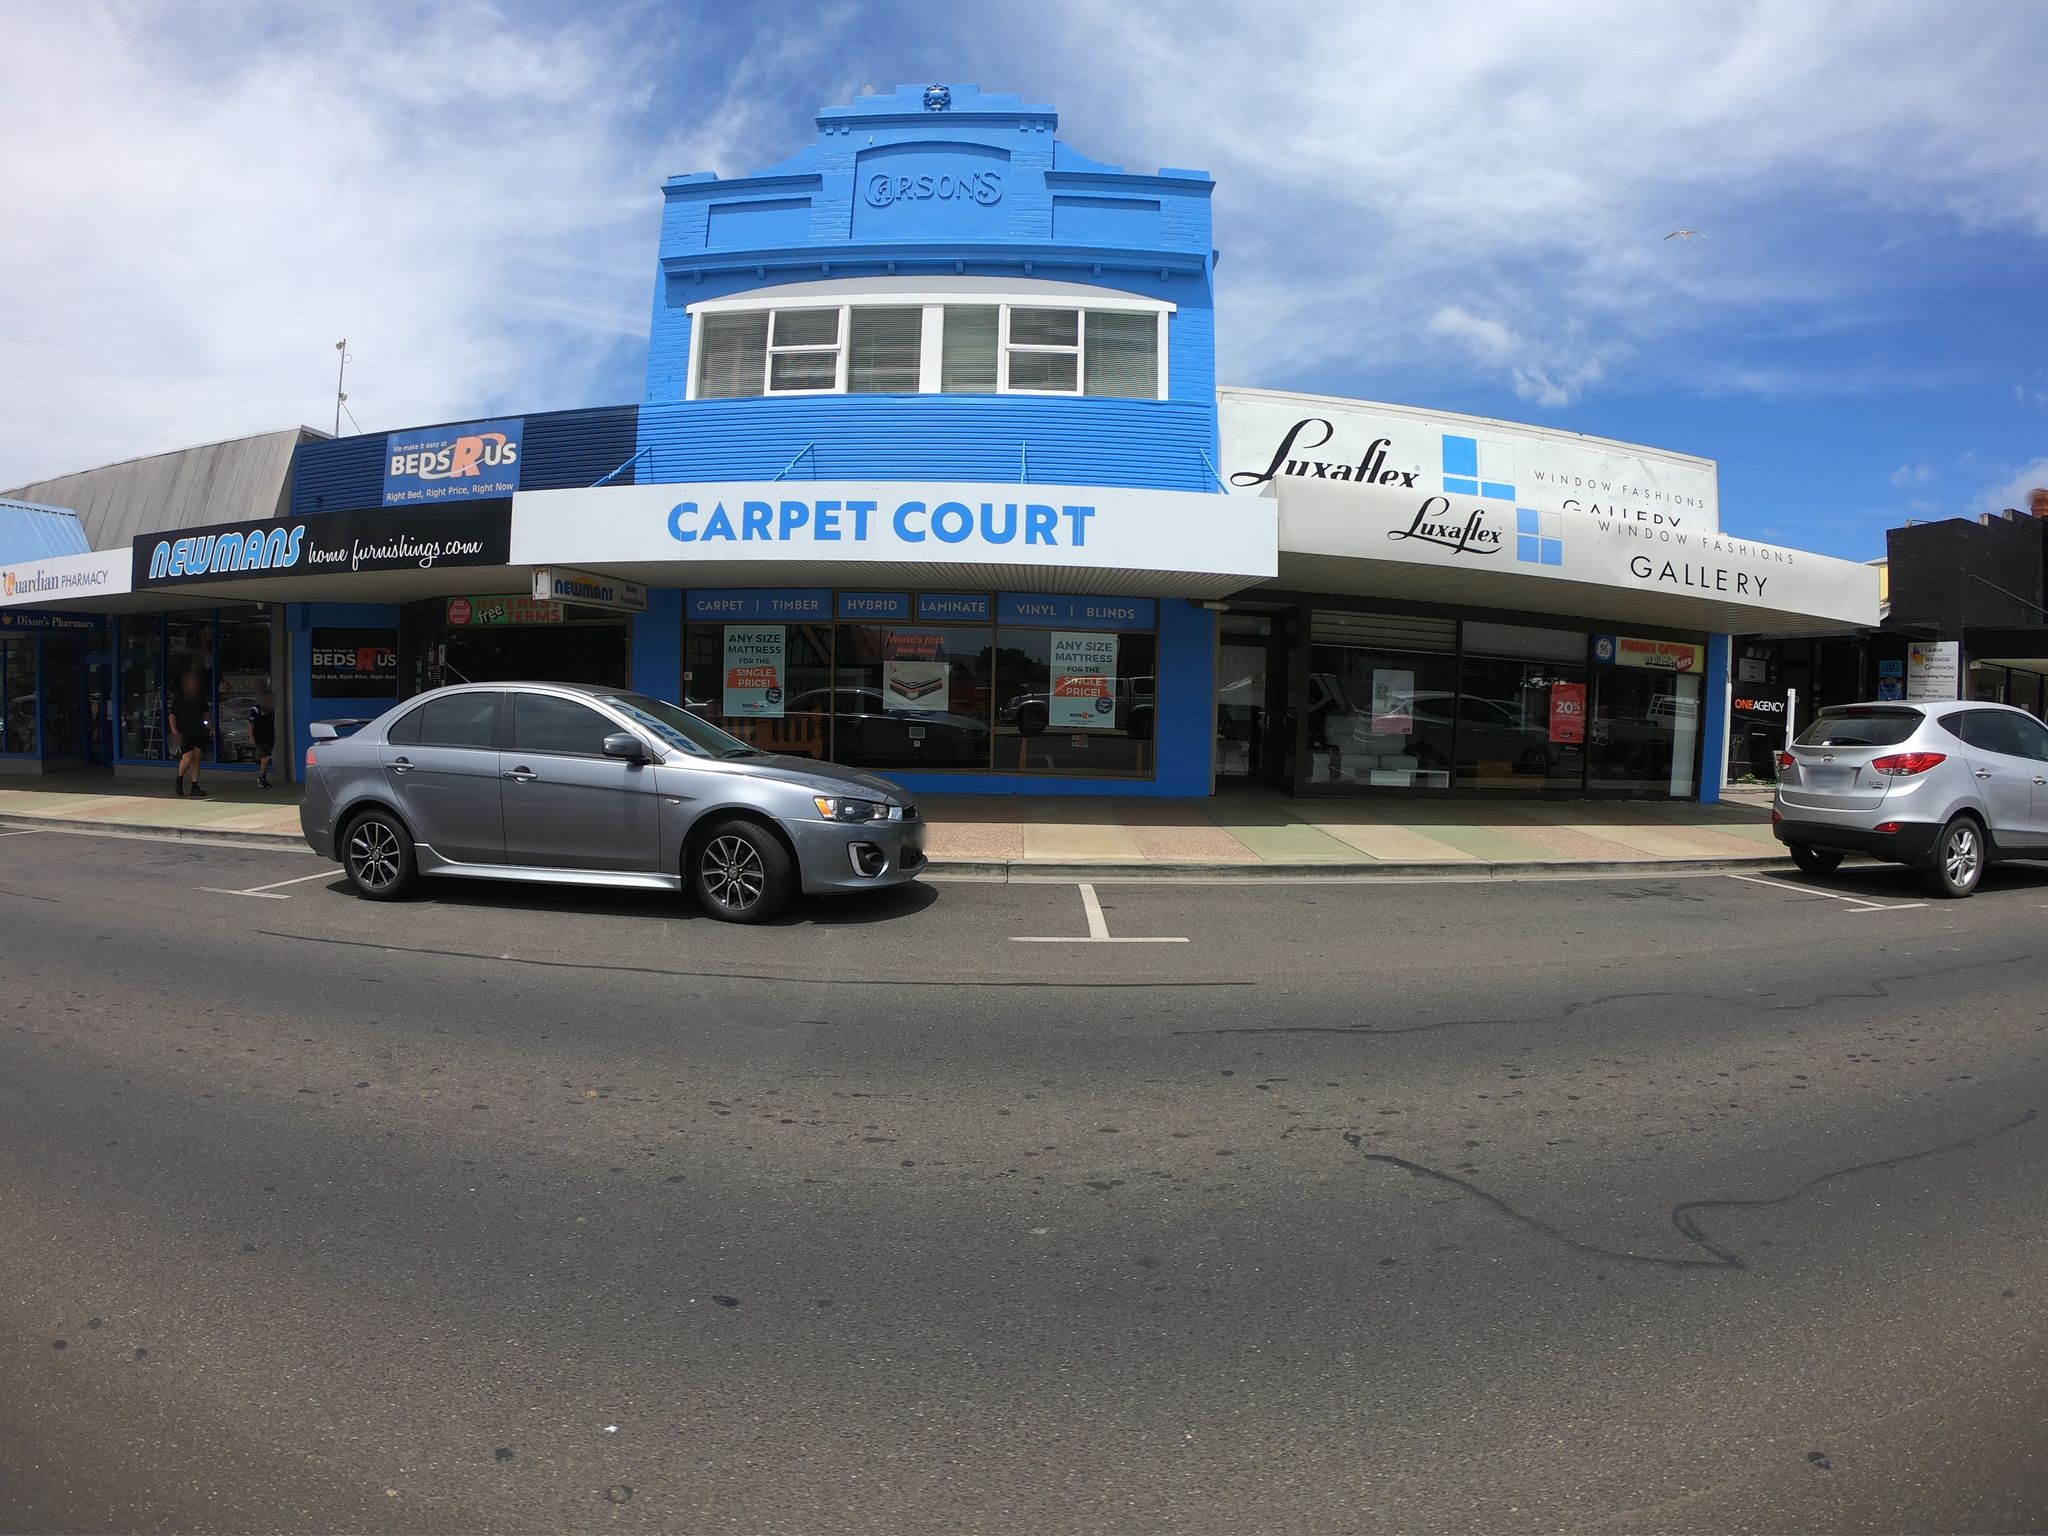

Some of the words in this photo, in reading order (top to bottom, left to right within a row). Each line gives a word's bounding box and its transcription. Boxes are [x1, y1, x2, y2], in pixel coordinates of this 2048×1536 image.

[864, 171, 1002, 208] CARSON'S
[426, 441, 439, 449] easy
[390, 449, 451, 478] BEDS
[484, 442, 517, 467] US
[1230, 418, 1419, 488] Luxaflex
[386, 492, 405, 503] Right
[407, 490, 424, 500] Bed,
[426, 489, 446, 499] Right
[448, 486, 470, 496] Price,
[472, 484, 494, 494] Right
[495, 482, 513, 491] Now
[1535, 471, 1611, 490] WINDOW
[1622, 485, 1703, 509] FASHIONS
[667, 501, 878, 542] CARPET
[893, 501, 1095, 547] COURT
[1387, 496, 1502, 555] Luxaflex
[1598, 520, 1687, 545] WINDOW
[1702, 538, 1794, 565] FASHIONS
[149, 525, 306, 579] NEWMANS
[309, 541, 349, 564] home
[352, 534, 483, 571] furnishings.com
[61, 570, 109, 588] PHARMACY
[1630, 556, 1768, 597] GALLERY
[453, 599, 465, 607] ask
[696, 600, 745, 611] CARPET
[771, 600, 820, 611] TIMBER
[847, 599, 898, 611] HYBRID
[921, 601, 986, 613] LAMINATE
[450, 607, 470, 616] about
[478, 604, 503, 624] free
[505, 609, 561, 623] TERMS
[1016, 603, 1057, 616] VINYL
[1086, 606, 1136, 619] BLINDS
[17, 614, 49, 627] Dixon's
[52, 616, 95, 630] Pharmacy
[729, 634, 754, 643] ANY
[755, 634, 781, 643] SIZE
[728, 645, 781, 654] MATTRESS
[1056, 640, 1084, 651] ANY
[1085, 642, 1113, 652] SIZE
[313, 653, 356, 666] BEDS
[377, 654, 397, 666] US
[1055, 653, 1113, 663] MATTRESS
[736, 668, 773, 677] SINGLE
[738, 679, 770, 688] PRICE!
[1063, 676, 1102, 686] SINGLE
[1066, 688, 1101, 697] PRICE!
[1556, 700, 1582, 715] 20%
